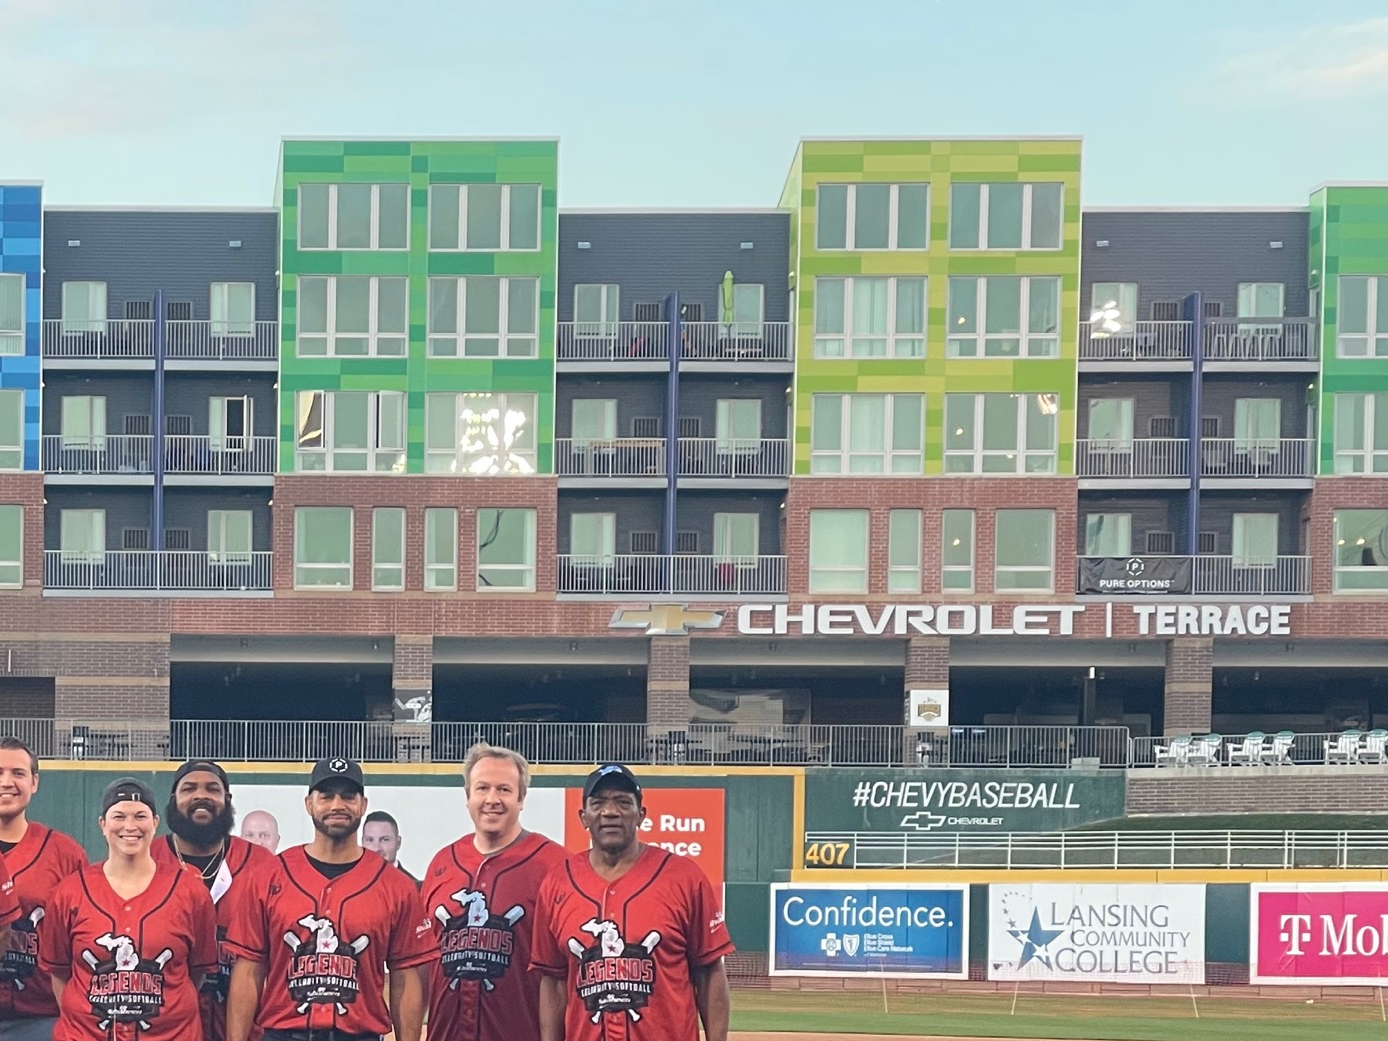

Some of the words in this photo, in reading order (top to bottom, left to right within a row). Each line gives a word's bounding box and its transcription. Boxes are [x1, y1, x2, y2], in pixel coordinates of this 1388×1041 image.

[1100, 580, 1125, 588] PURE
[1127, 580, 1171, 588] OPTIONS
[737, 604, 1086, 635] CHEVROLET
[1132, 605, 1291, 635] TERRACE
[853, 781, 1080, 808] #CHEVYBASEBALL
[660, 814, 706, 832] Run
[948, 816, 1004, 826] CHEVROLET
[806, 842, 850, 865] 407
[783, 895, 954, 928] Confidence.
[1051, 902, 1170, 928] LANSING
[441, 927, 513, 955] LEGENDS
[1071, 930, 1191, 948] COMMUNITY
[288, 953, 357, 979] LEGENDS
[577, 957, 653, 987] LEGENDS
[1055, 948, 1178, 974] COLLEGE
[90, 972, 163, 996] LEGENDS
